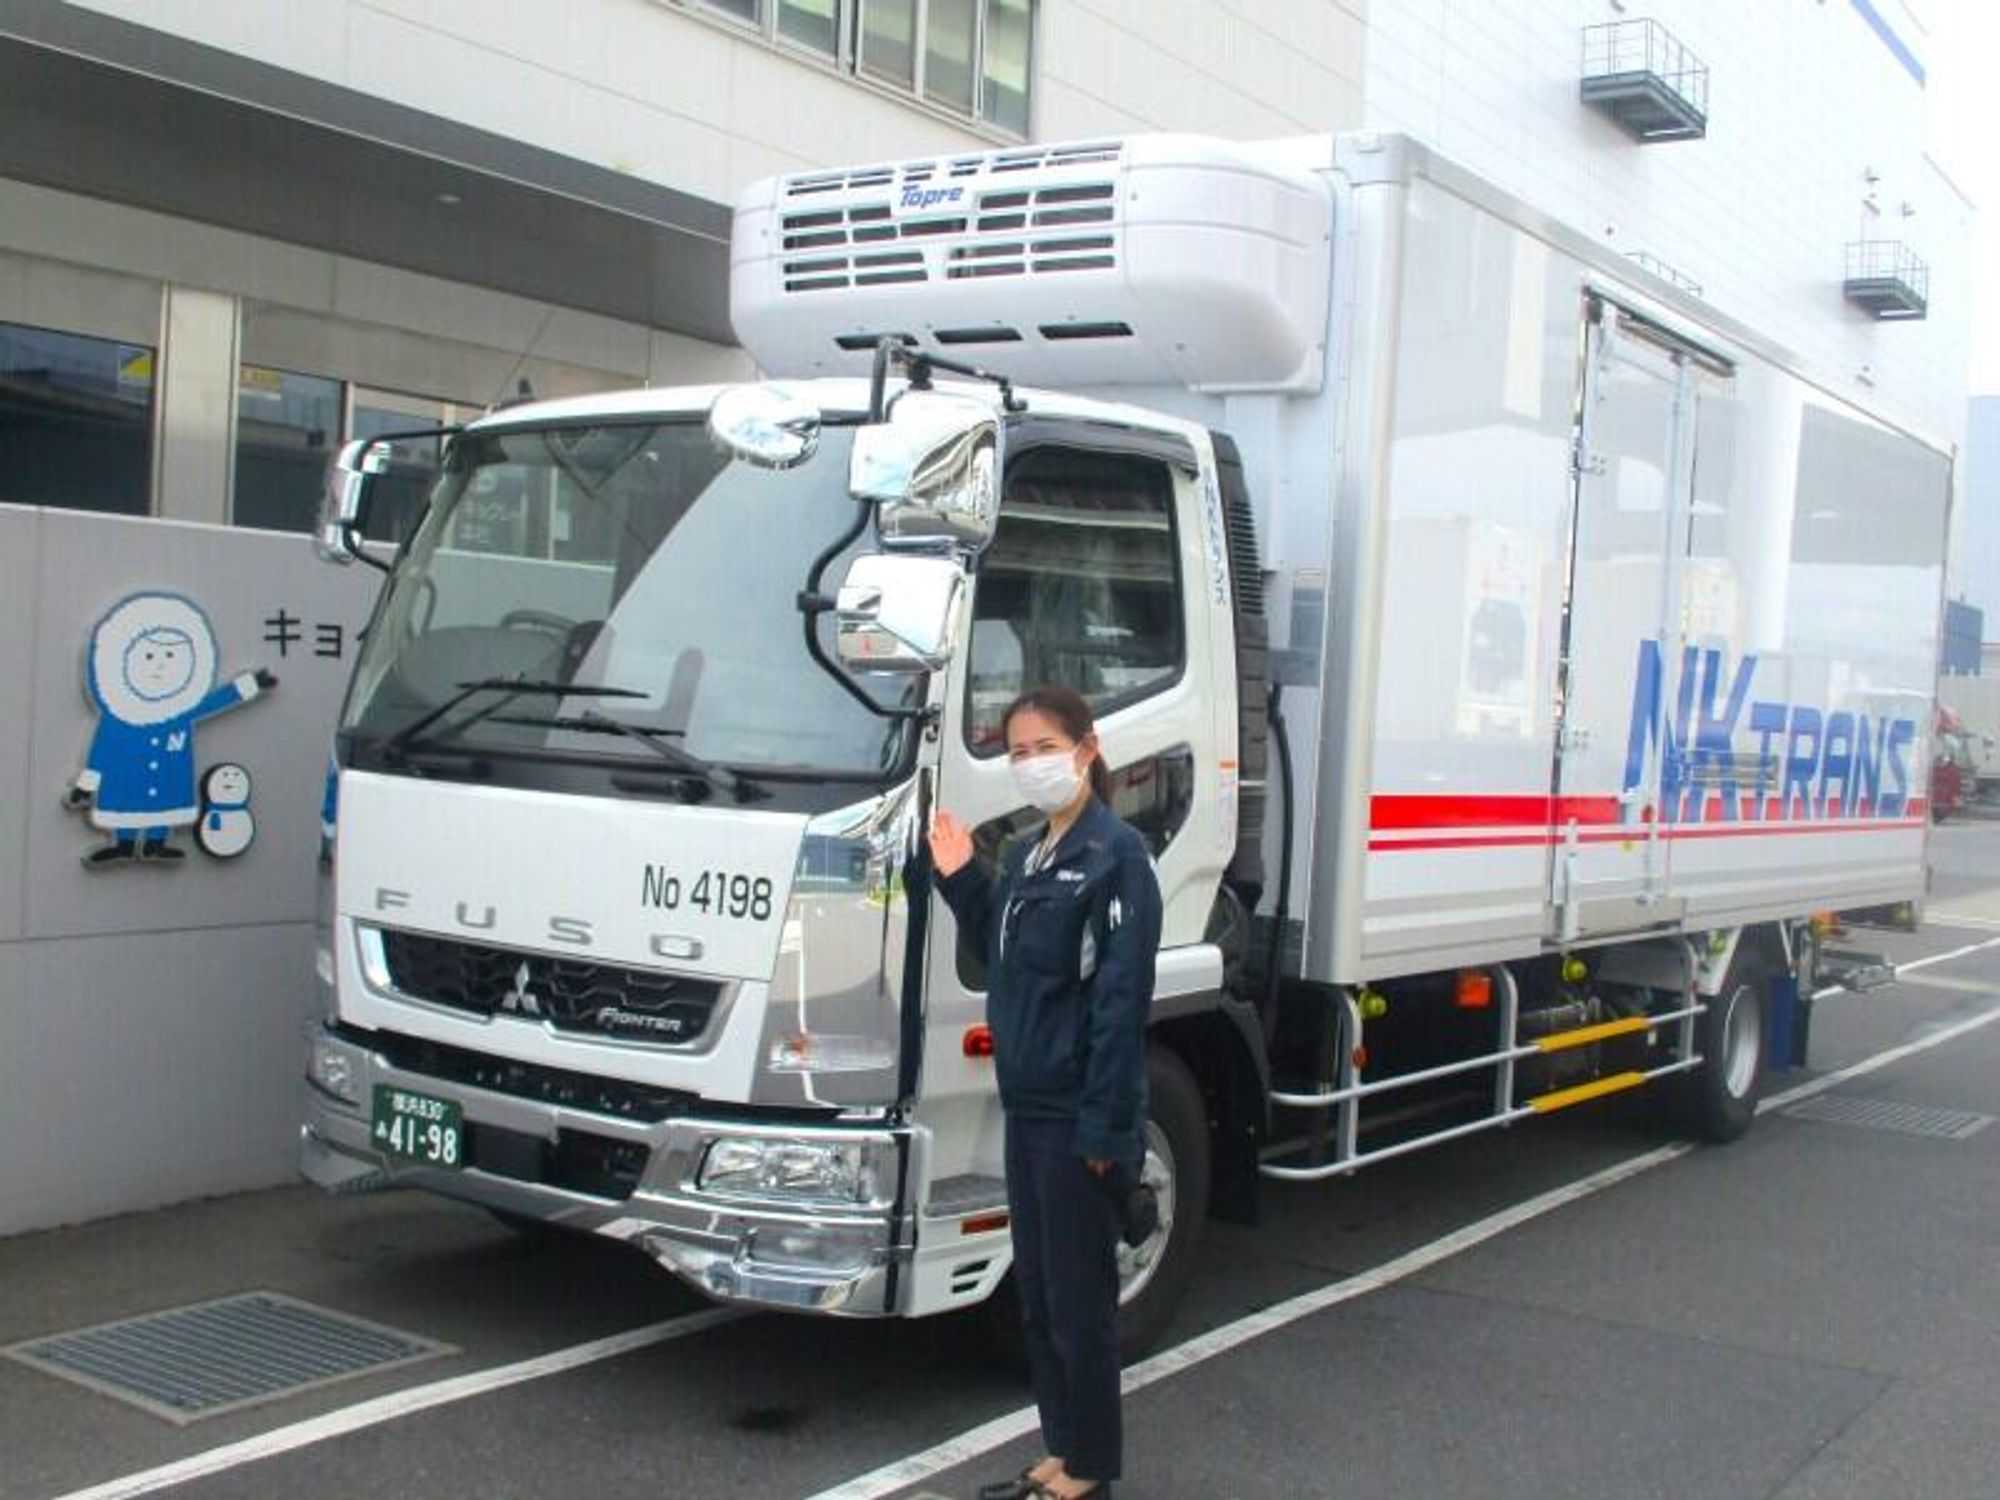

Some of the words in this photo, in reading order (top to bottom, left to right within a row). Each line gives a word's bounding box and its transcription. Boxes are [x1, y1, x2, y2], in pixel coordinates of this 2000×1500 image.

[901, 185, 964, 209] Topre
[263, 608, 366, 659] キョ
[642, 864, 680, 910] No
[690, 870, 773, 921] 4198
[375, 887, 704, 962] FUSO
[390, 1115, 457, 1164] 41-98
